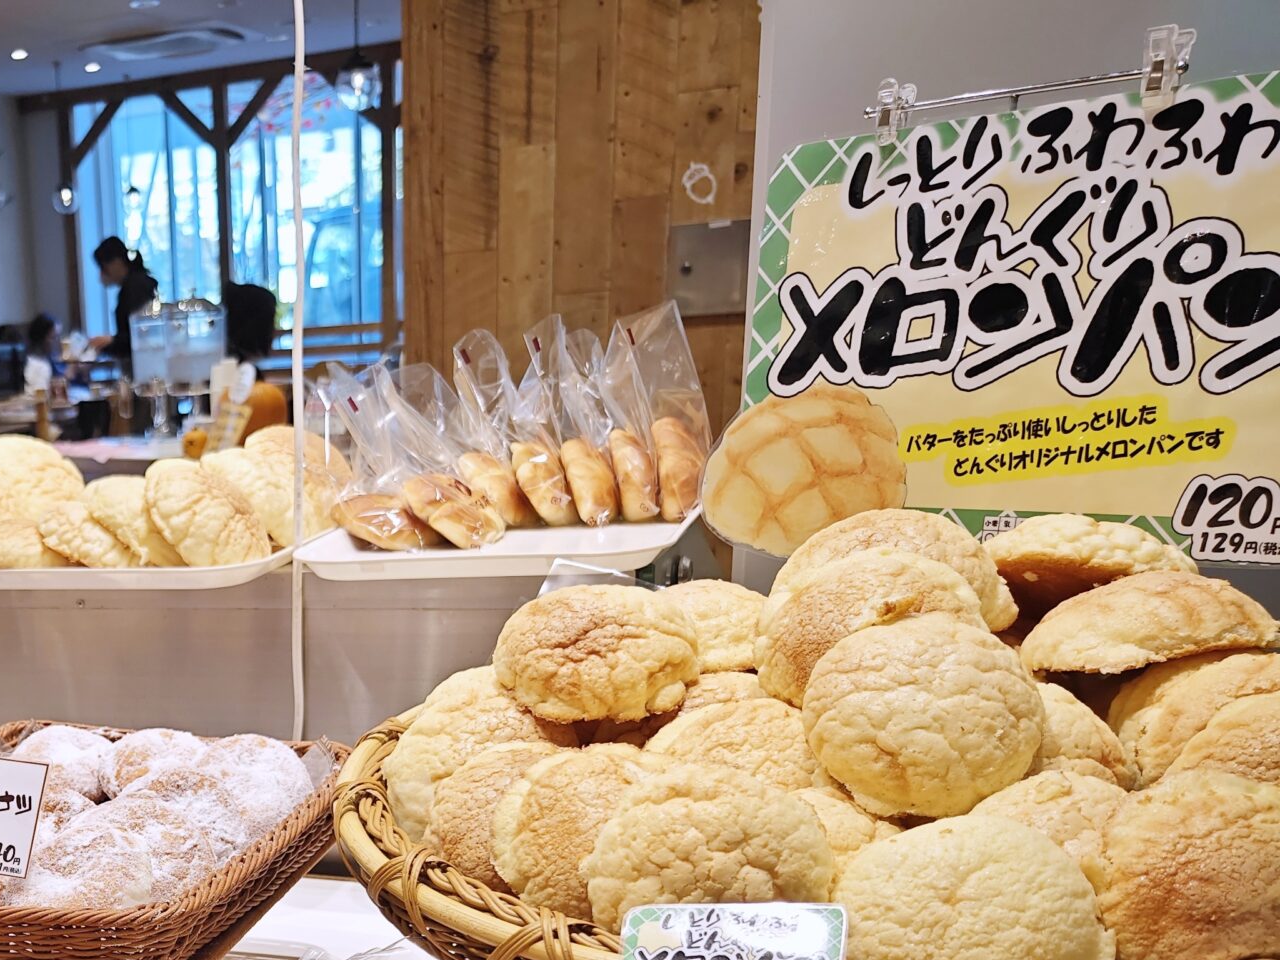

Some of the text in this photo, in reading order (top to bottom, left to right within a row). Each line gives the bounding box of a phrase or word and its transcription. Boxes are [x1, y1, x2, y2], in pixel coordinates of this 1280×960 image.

[849, 102, 1280, 209] しっとり ふわふわ
[907, 177, 1158, 270] どんぐり
[779, 233, 1280, 386] メロンパン
[907, 405, 1157, 453] バターをたっぷり使いしっとりした
[1199, 532, 1280, 555] 129円(税
